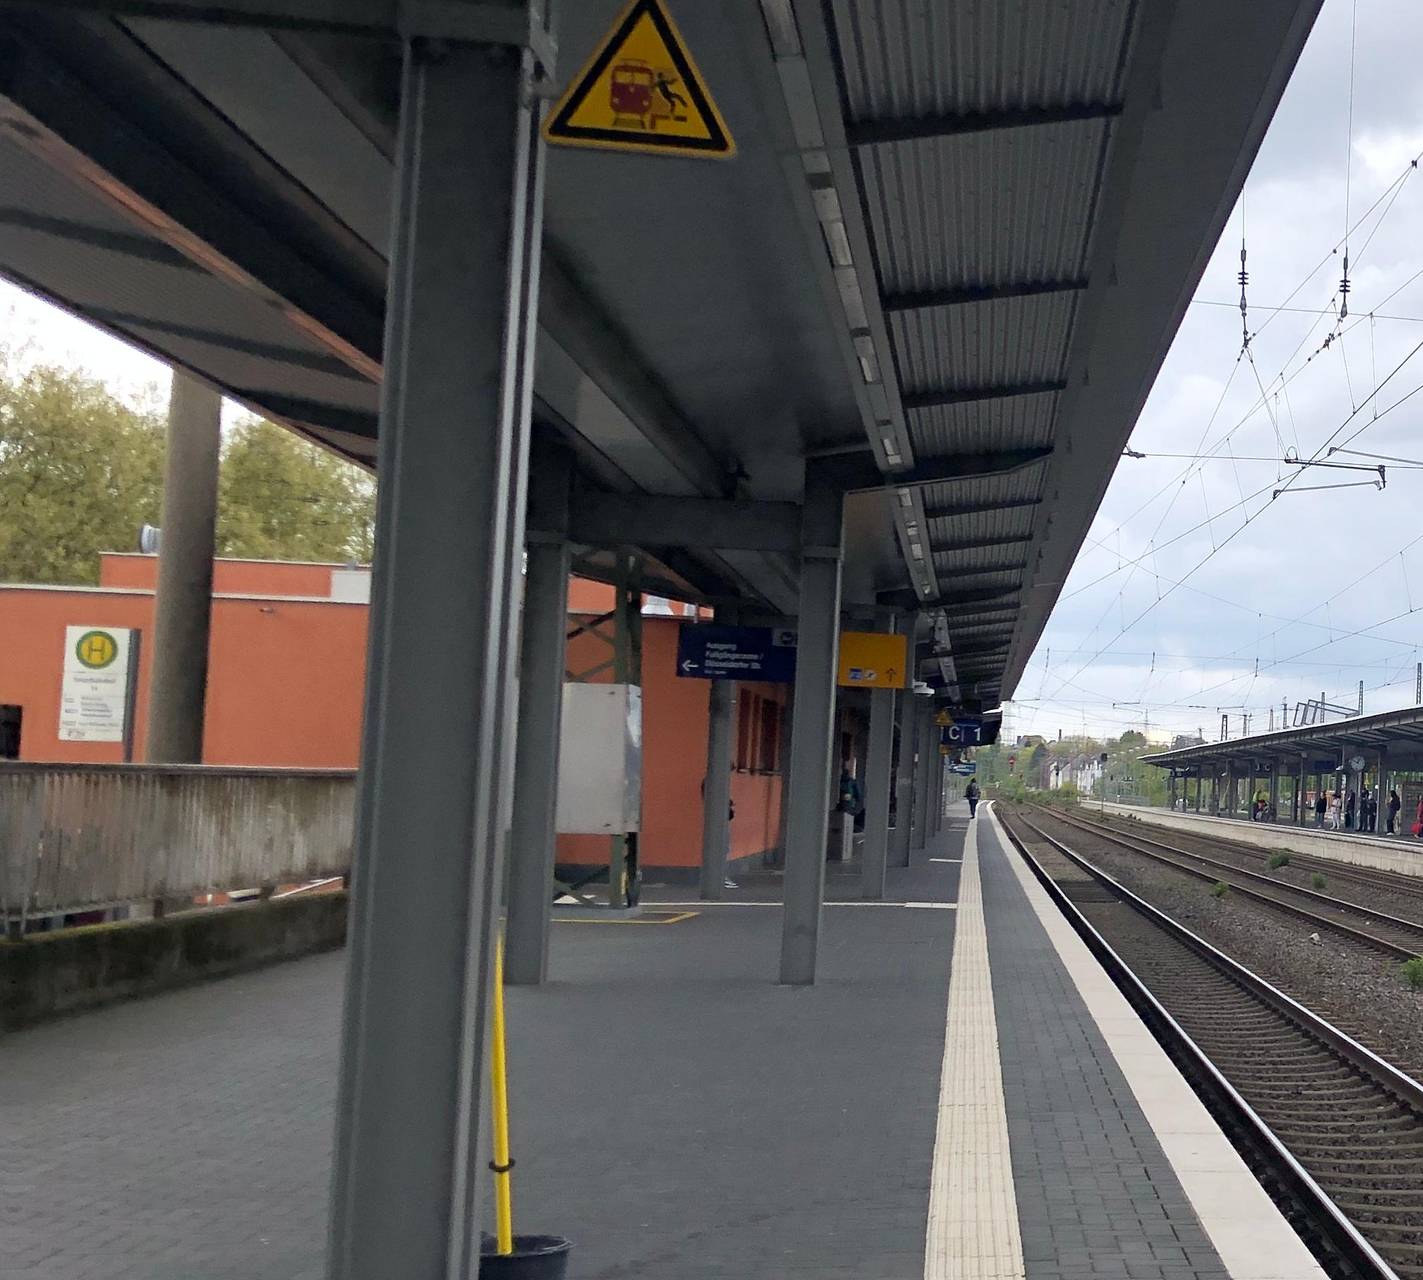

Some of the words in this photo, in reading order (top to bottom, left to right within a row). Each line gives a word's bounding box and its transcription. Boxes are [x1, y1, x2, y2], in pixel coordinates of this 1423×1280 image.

[88, 639, 106, 661] H
[949, 726, 960, 740] C
[974, 727, 981, 741] 1
